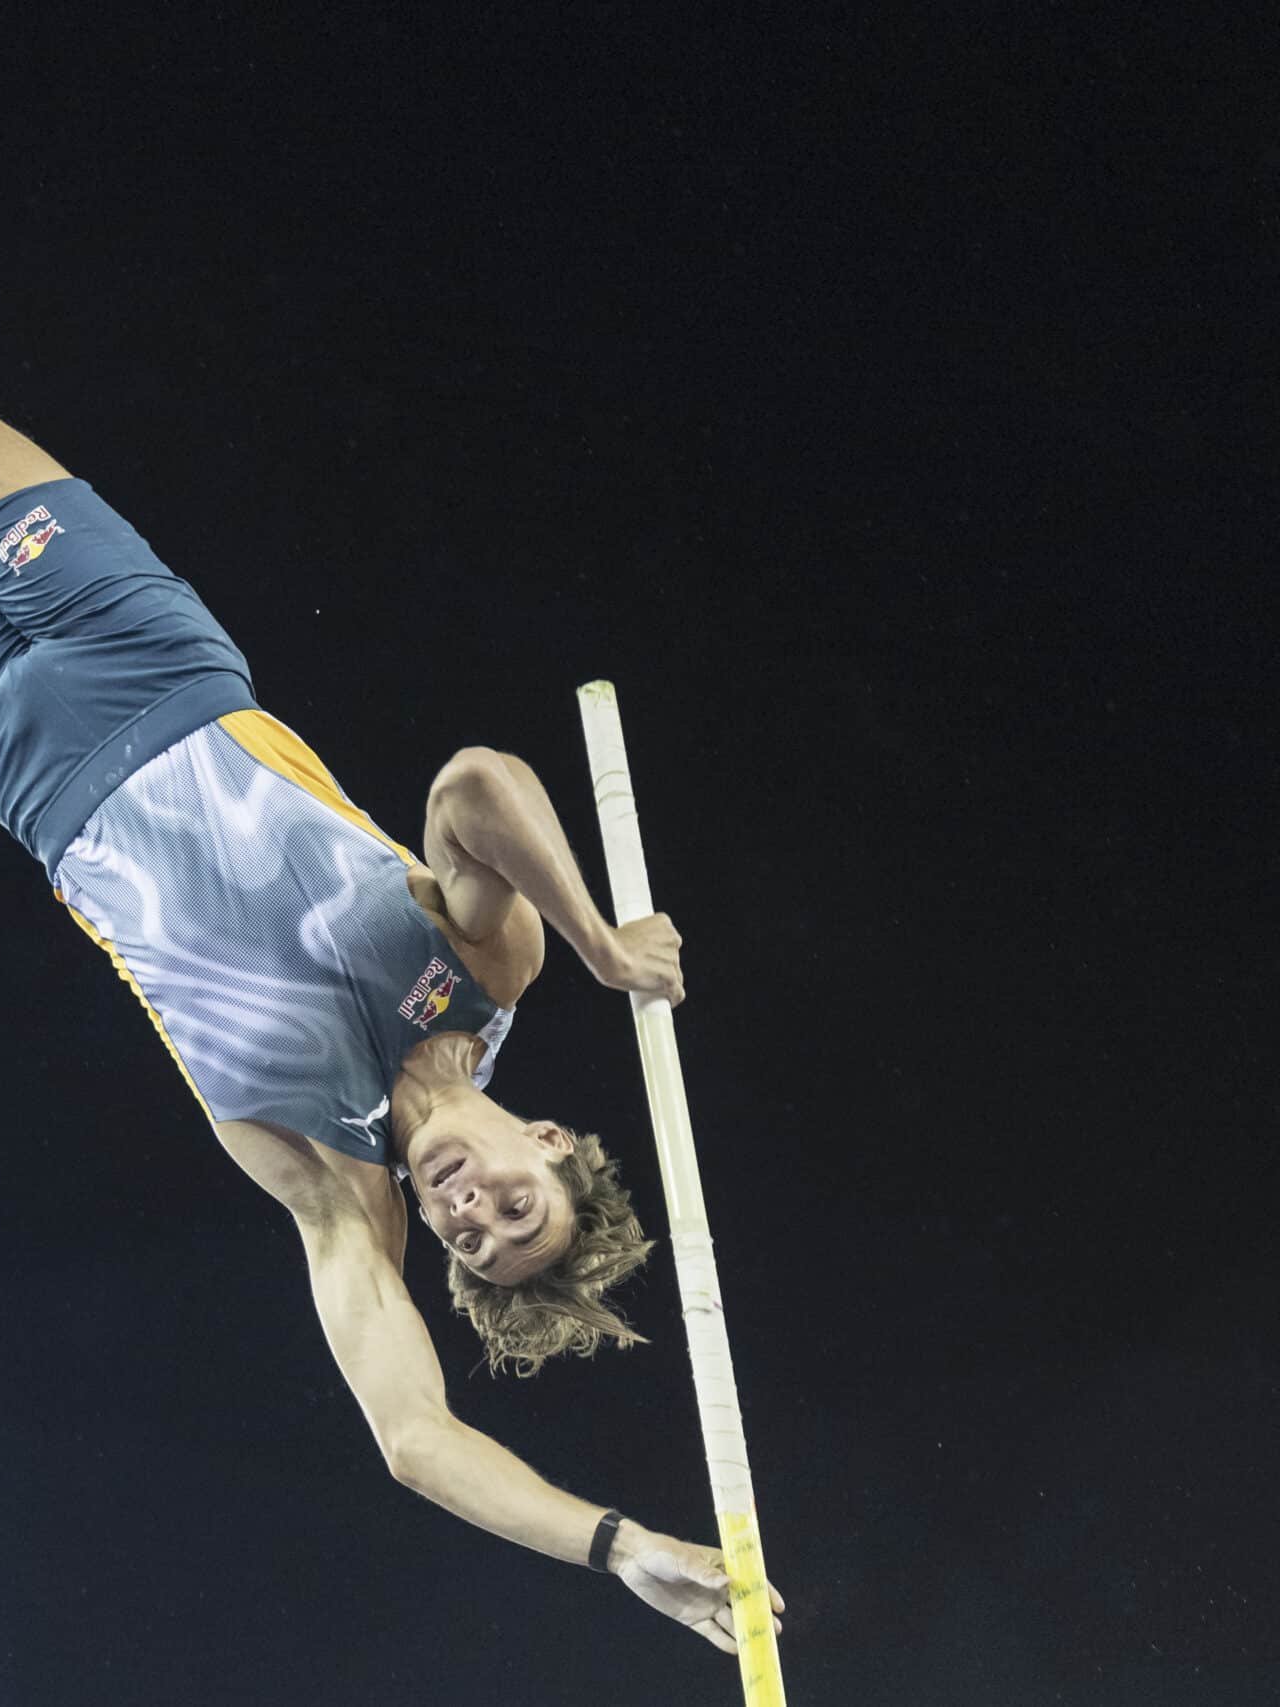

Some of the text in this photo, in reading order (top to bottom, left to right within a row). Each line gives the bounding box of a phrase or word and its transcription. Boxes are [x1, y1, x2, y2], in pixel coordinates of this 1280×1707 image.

[16, 505, 51, 538] Red
[398, 957, 448, 1020] Red Bull
